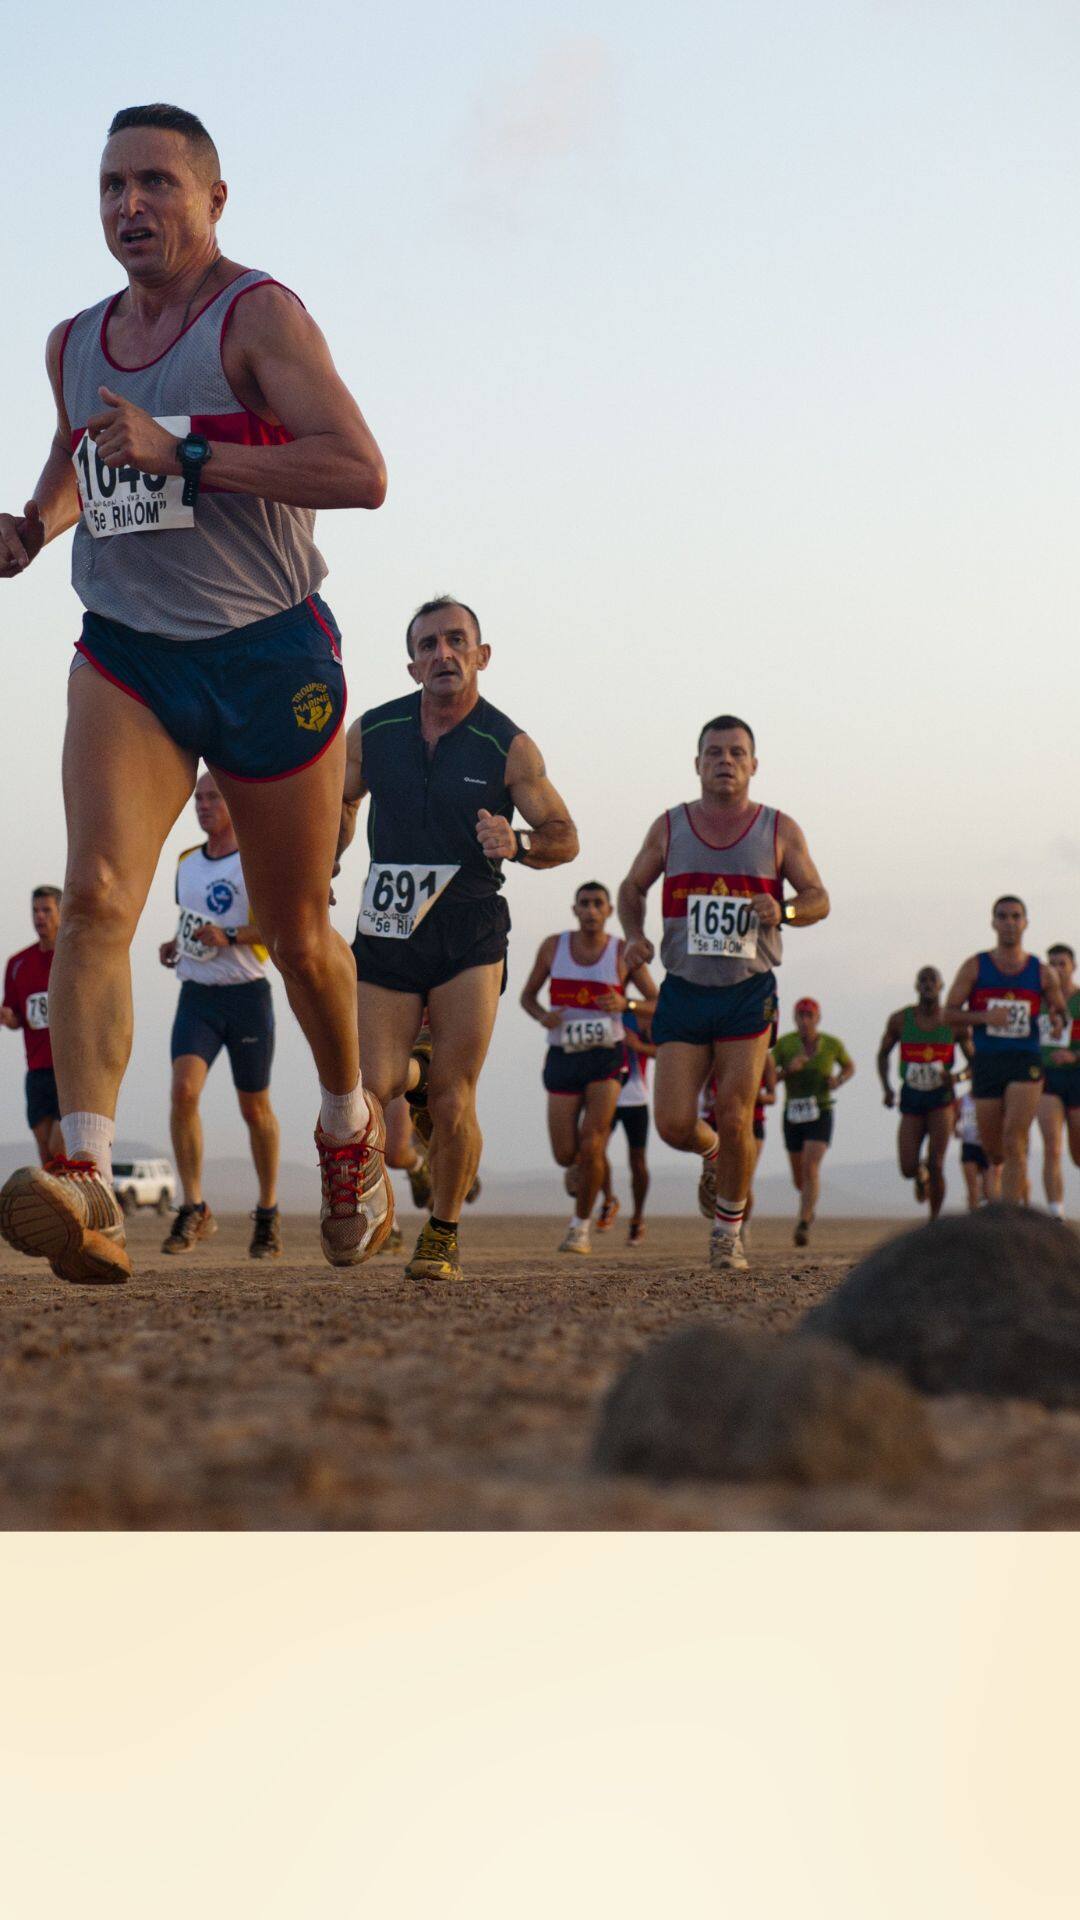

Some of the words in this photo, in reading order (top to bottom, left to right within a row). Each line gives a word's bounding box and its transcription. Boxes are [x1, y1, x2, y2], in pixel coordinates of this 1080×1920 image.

[372, 870, 437, 914] 691
[690, 900, 750, 937] 1650
[566, 1022, 605, 1044] 1159
